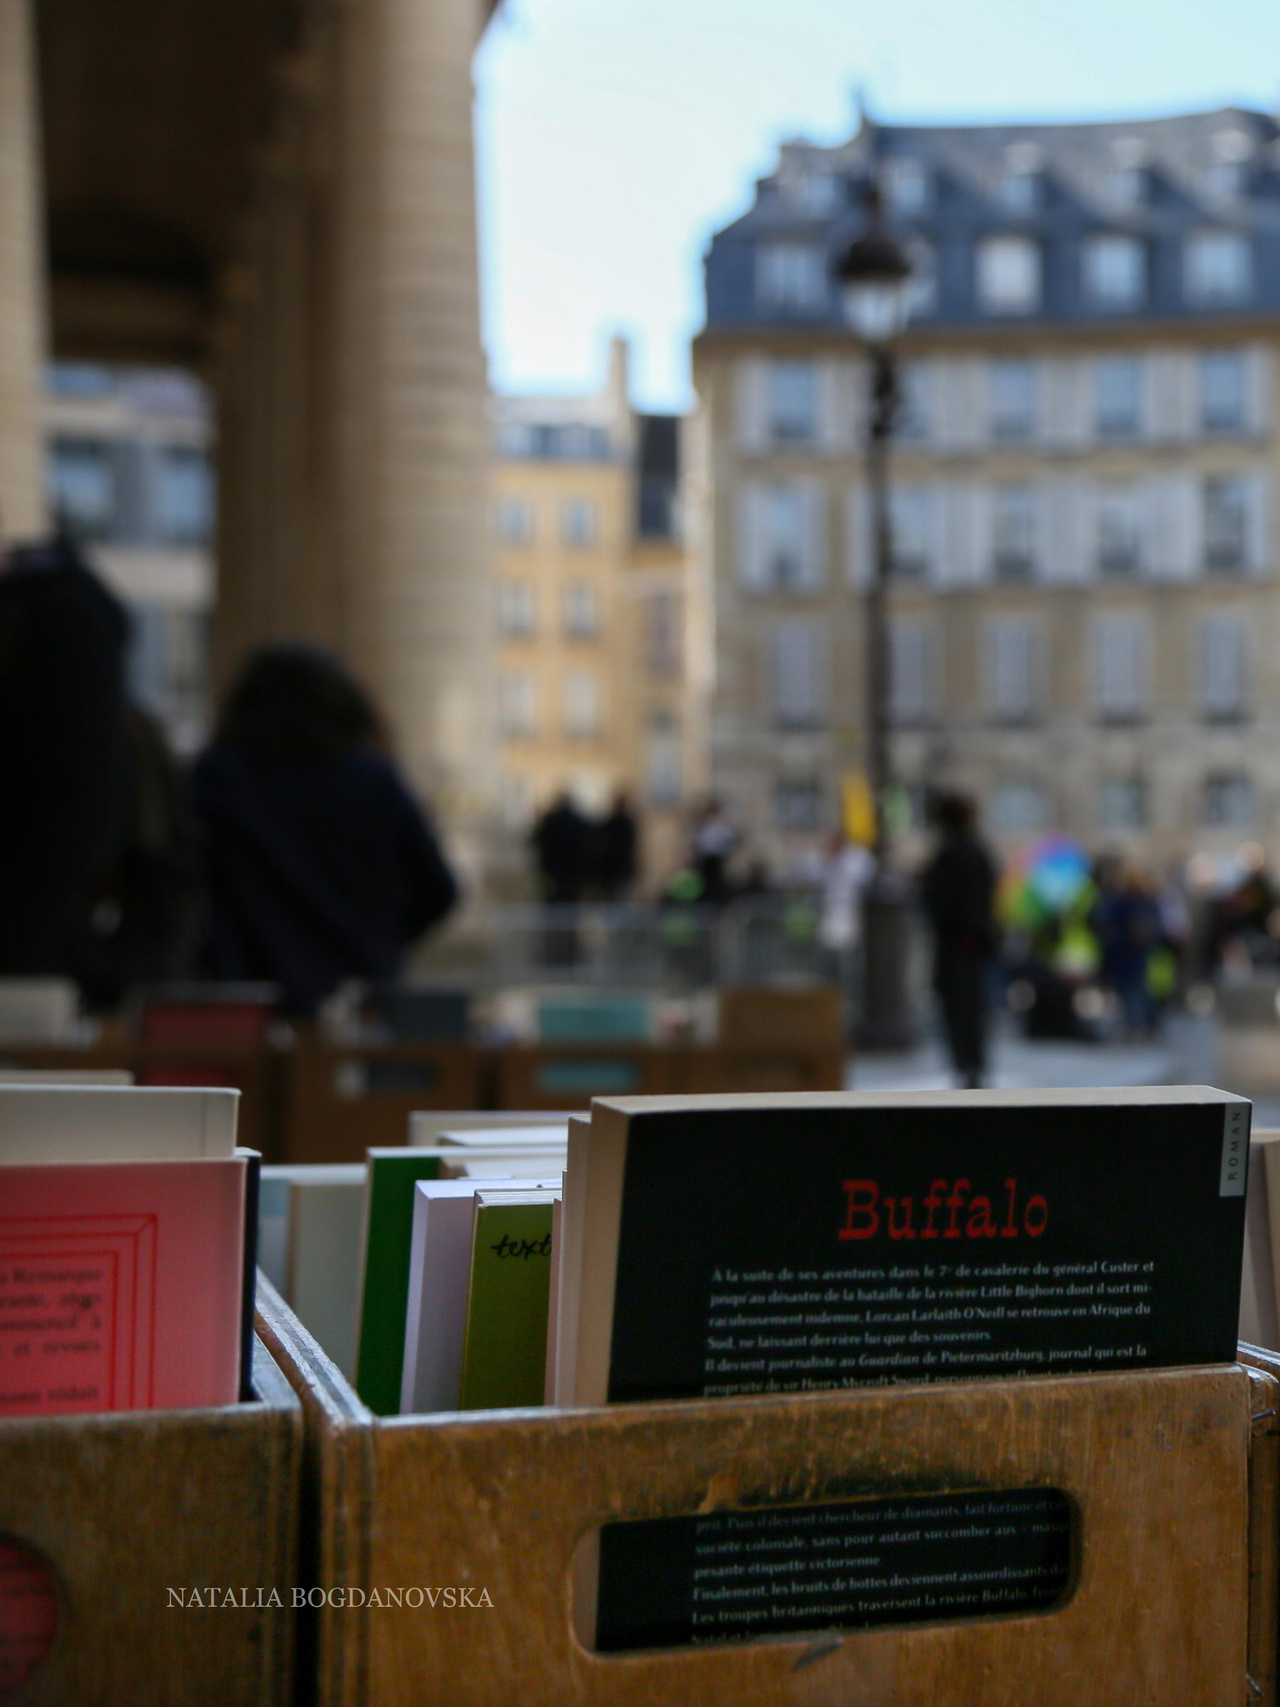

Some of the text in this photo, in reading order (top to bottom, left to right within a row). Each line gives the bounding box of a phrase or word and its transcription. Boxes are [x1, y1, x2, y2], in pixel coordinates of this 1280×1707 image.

[1227, 1112, 1241, 1181] ROMAN
[837, 1178, 1050, 1240] Buffalo
[778, 1268, 795, 1281] de
[888, 1266, 920, 1278] dans
[924, 1265, 936, 1277] le
[955, 1264, 971, 1276] de
[974, 1263, 1030, 1276] cavalerie
[1032, 1262, 1050, 1275] du
[1052, 1261, 1098, 1277] général
[1100, 1260, 1138, 1273] Custer
[1142, 1261, 1154, 1272] et
[824, 1289, 840, 1301] de
[842, 1289, 854, 1301] la
[906, 1287, 922, 1300] de
[924, 1287, 936, 1299] la
[980, 1285, 1012, 1298] Little
[1014, 1284, 1064, 1300] Bighorn
[1066, 1283, 1094, 1296] dont
[1096, 1283, 1104, 1295] il
[1106, 1284, 1130, 1295] sort
[1006, 1310, 1020, 1319] se
[1020, 1307, 1070, 1318] retrouve
[1072, 1308, 1087, 1317] en
[1090, 1304, 1134, 1319] Afrique
[1135, 1303, 1152, 1315] du
[1048, 1344, 1146, 1362] journal qui est la
